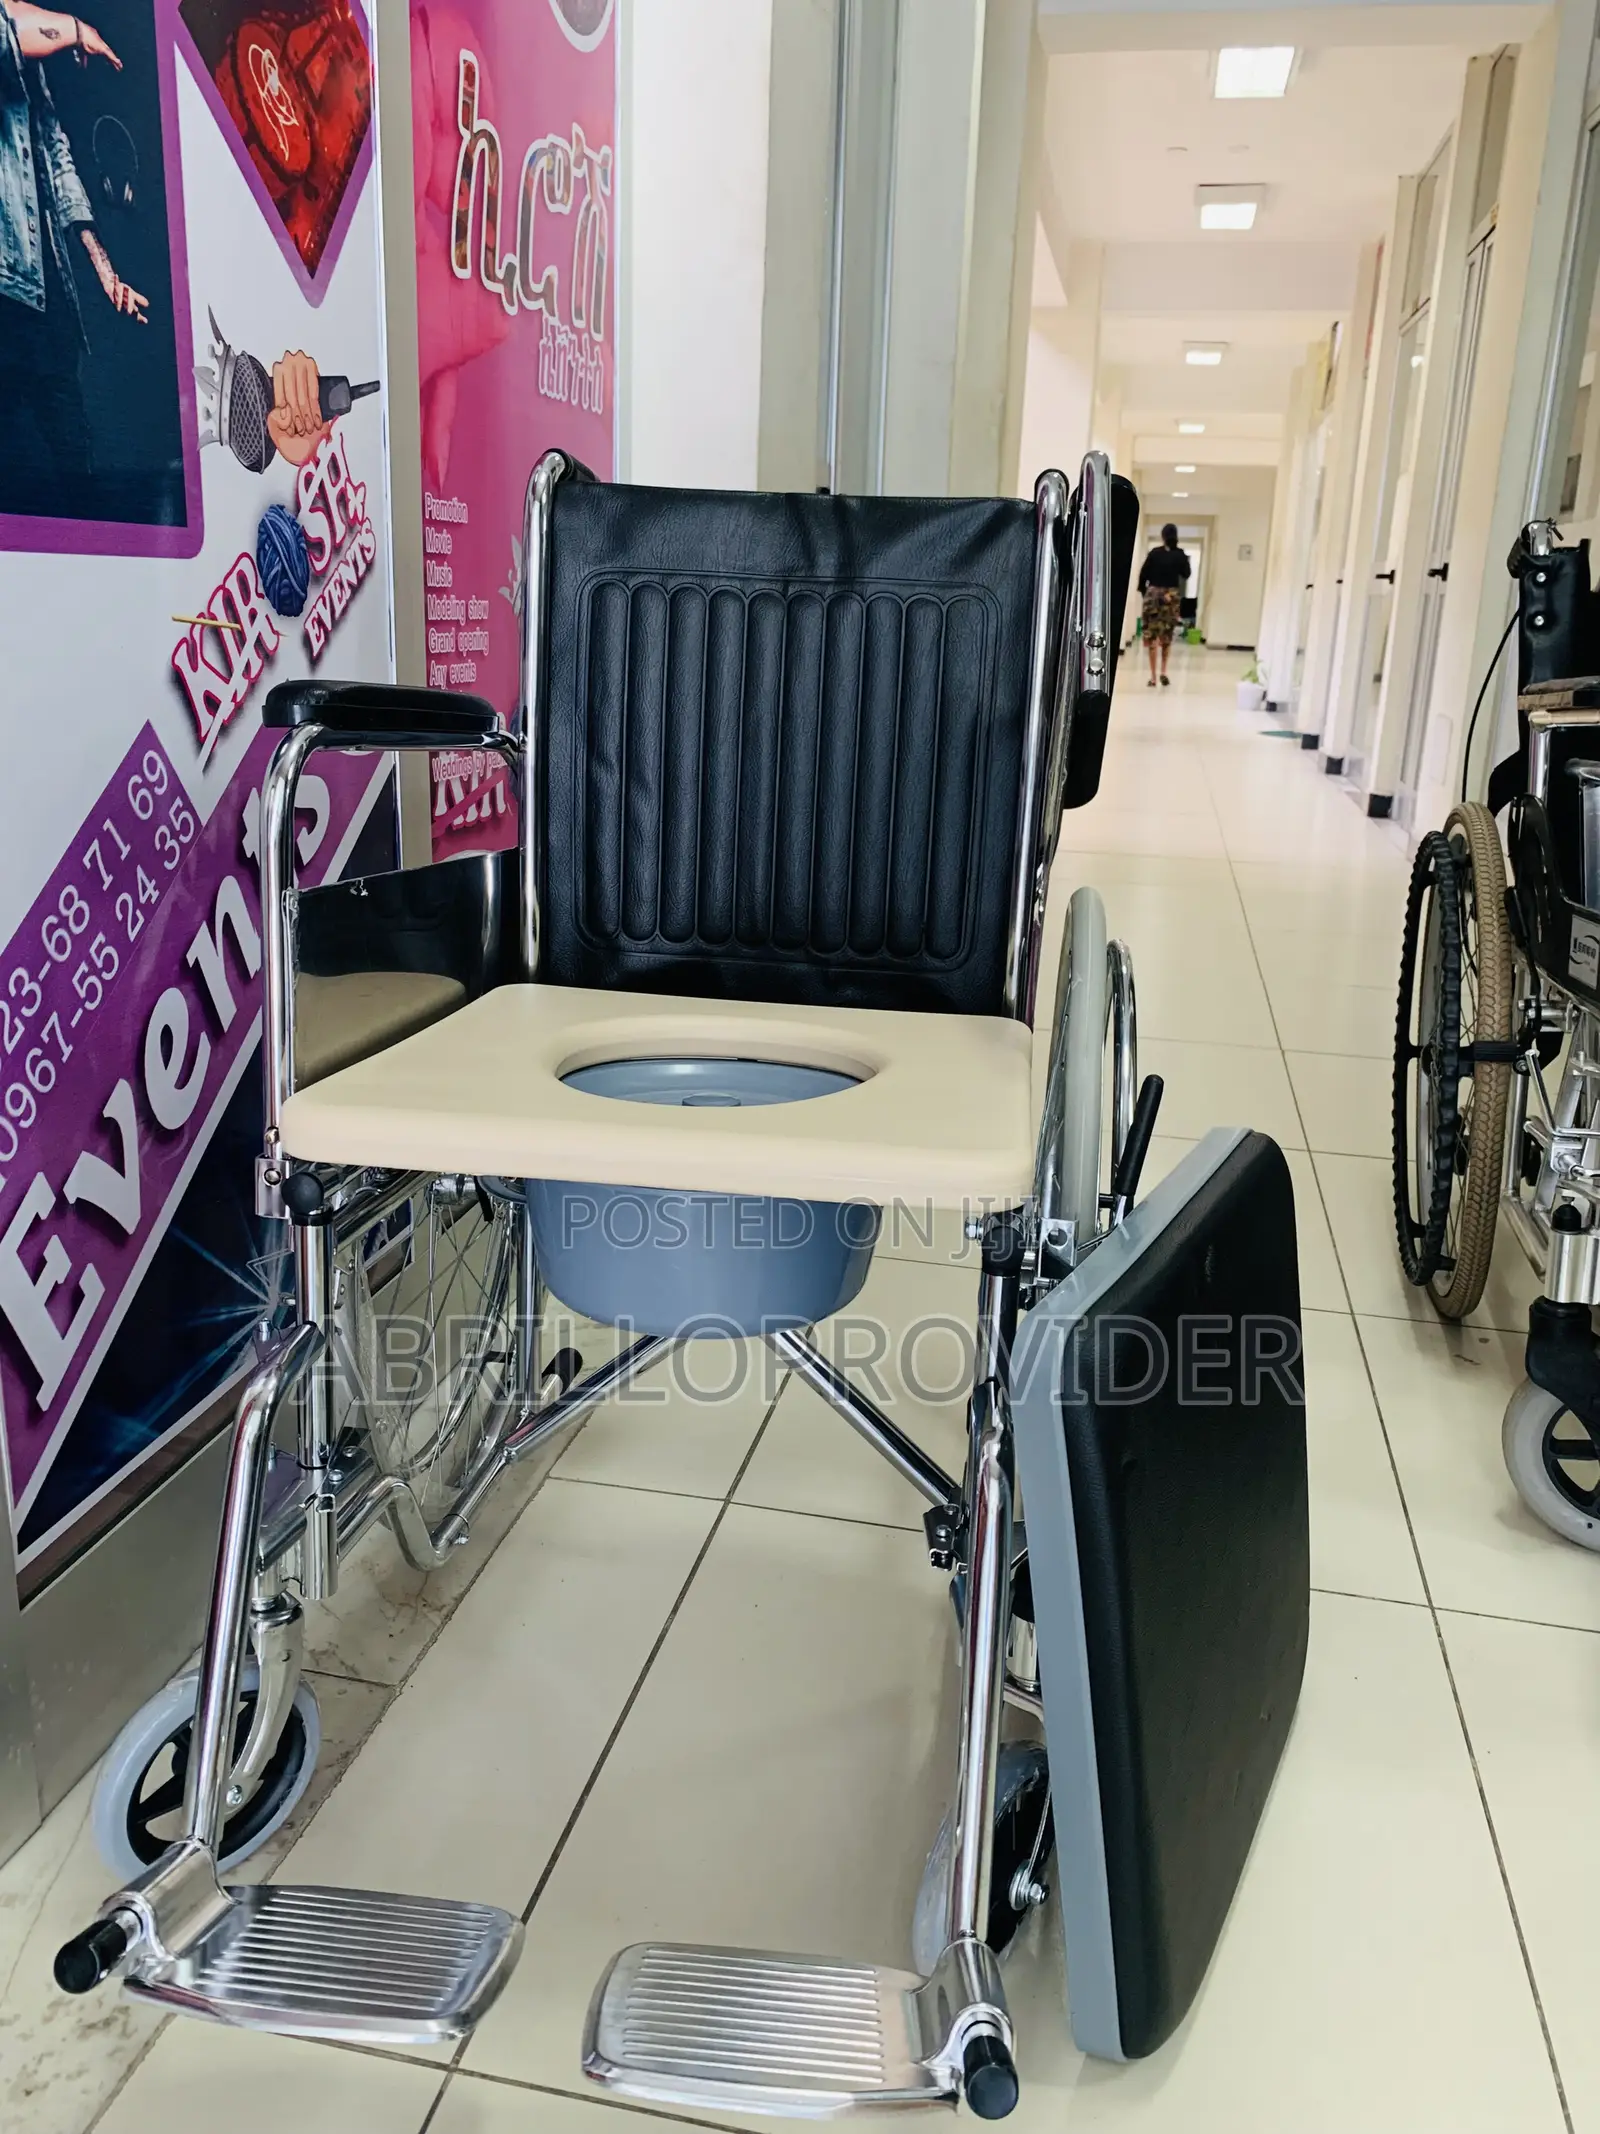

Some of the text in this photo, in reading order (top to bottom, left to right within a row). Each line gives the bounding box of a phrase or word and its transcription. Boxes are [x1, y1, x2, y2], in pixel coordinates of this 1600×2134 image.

[425, 492, 468, 523] Promotion
[425, 527, 452, 554] Movie
[304, 518, 377, 658] EVENTS
[426, 560, 452, 587] Music
[427, 594, 489, 626] Modeling show
[428, 627, 489, 656] Grand opening
[429, 659, 476, 689] Any events
[432, 753, 472, 782] Weddings
[82, 818, 131, 891] 71
[127, 750, 169, 820] 69
[115, 864, 160, 942] 24
[154, 796, 195, 870] 35
